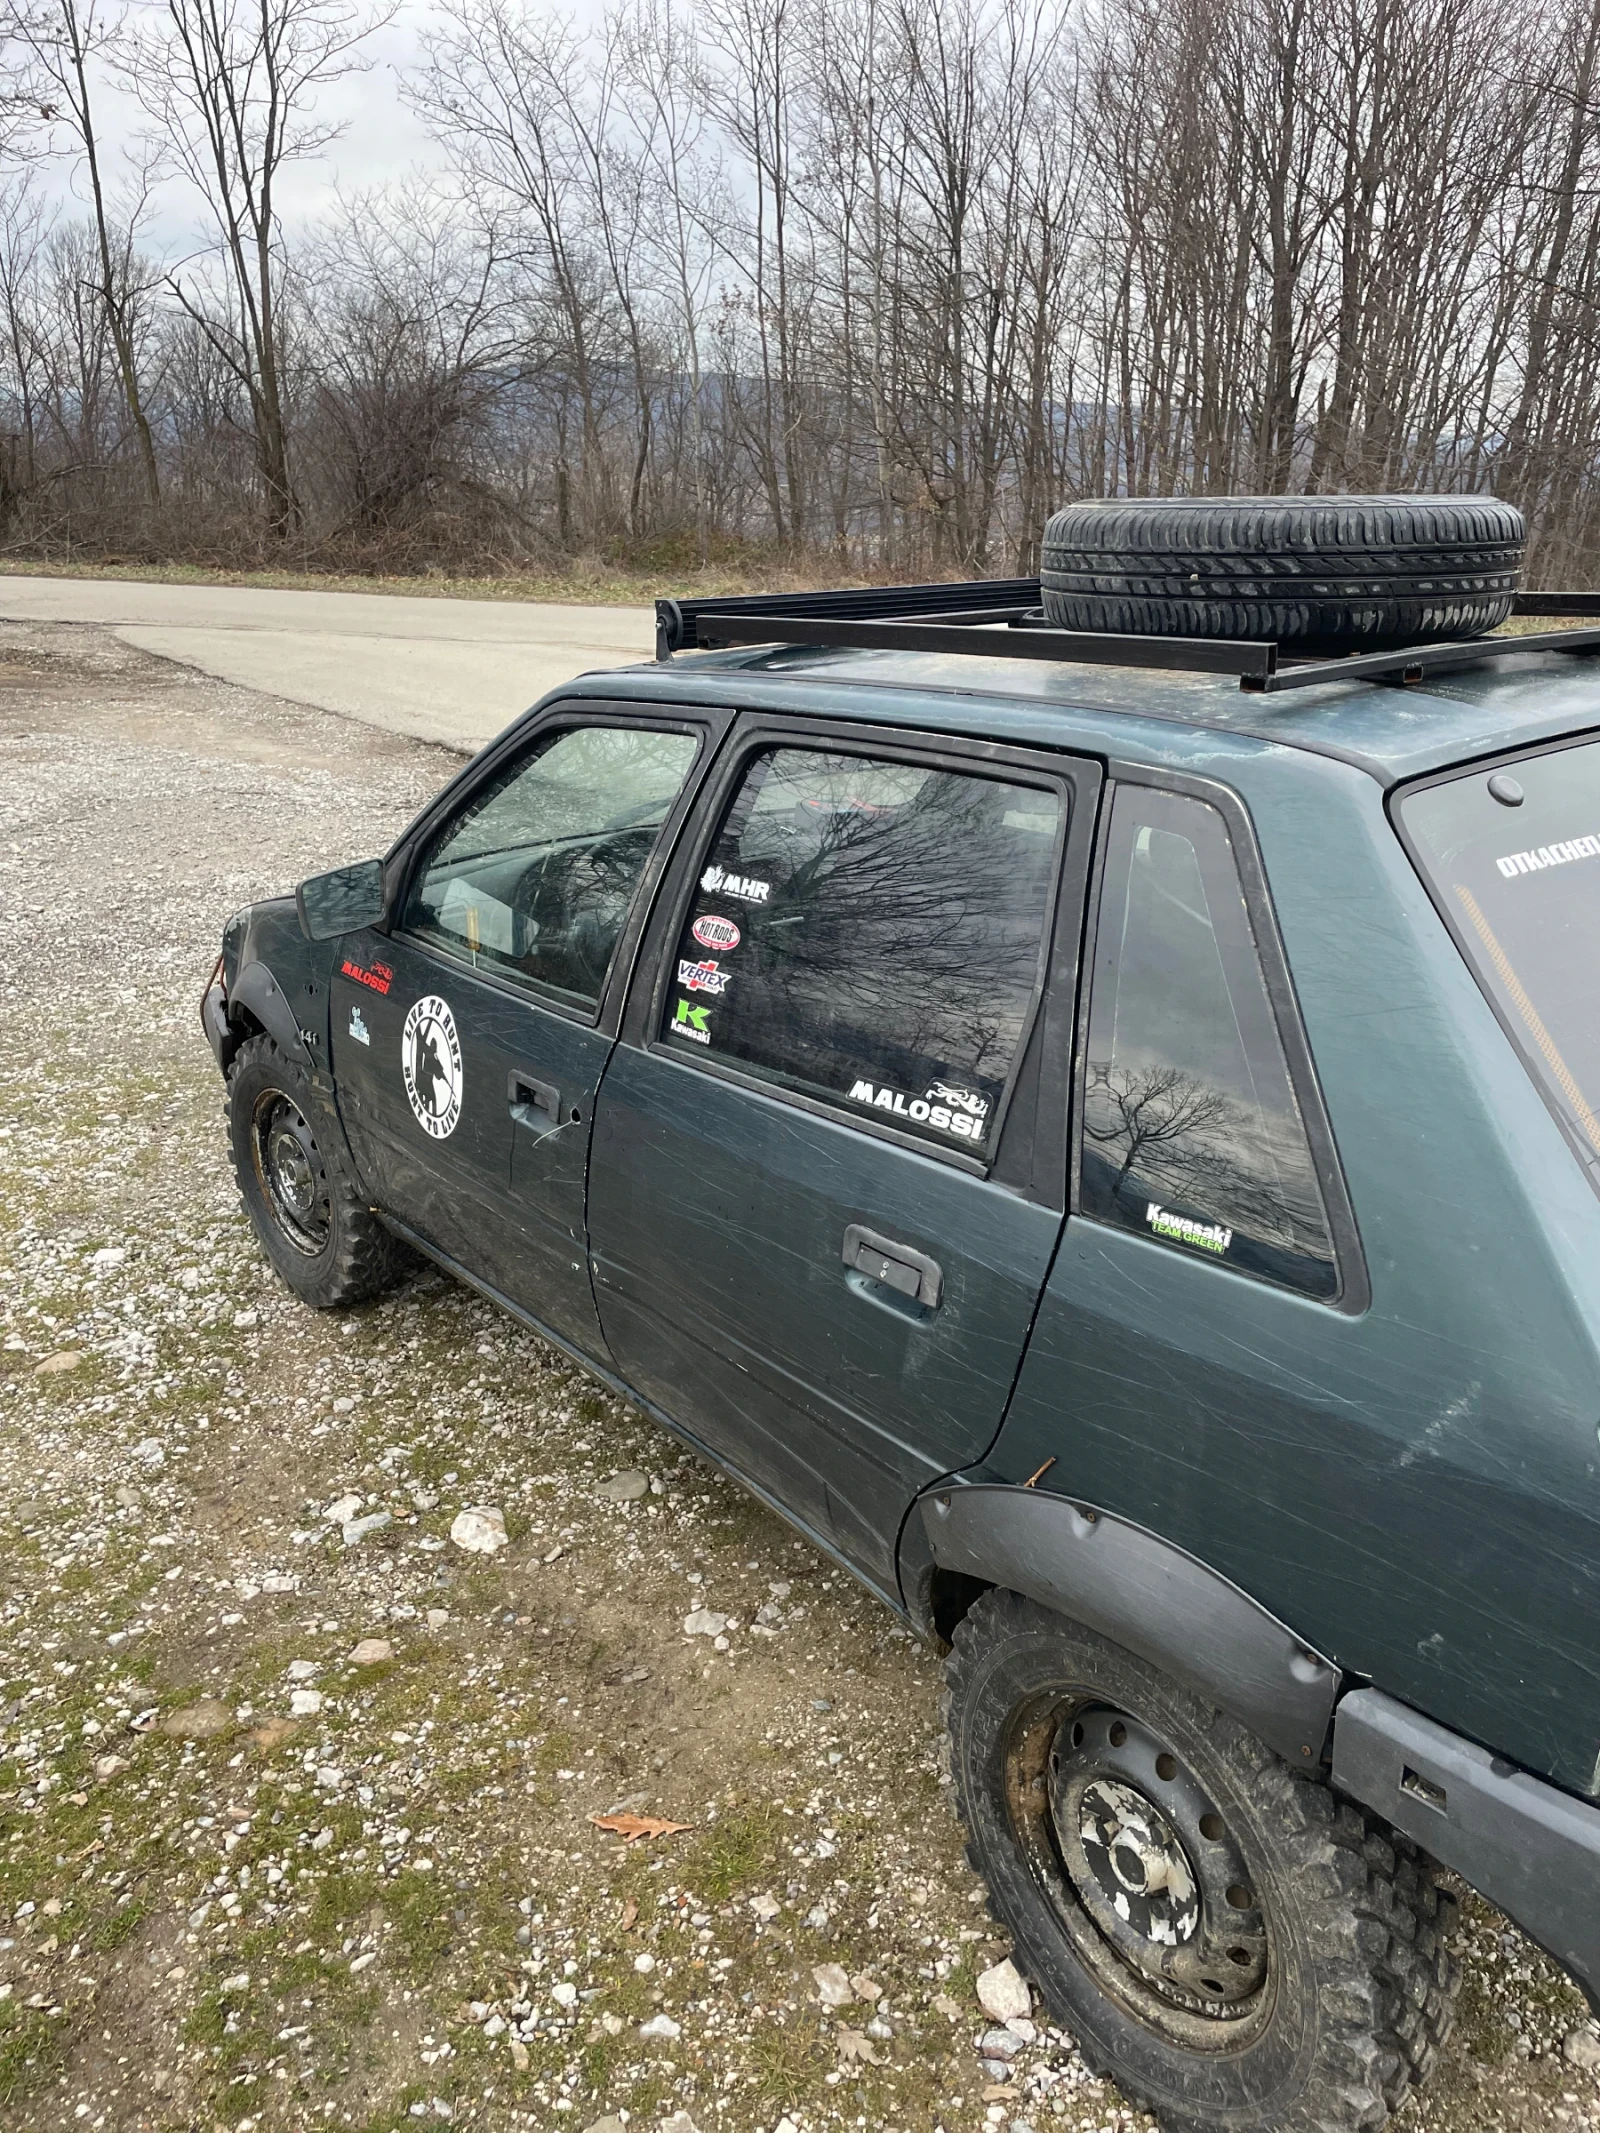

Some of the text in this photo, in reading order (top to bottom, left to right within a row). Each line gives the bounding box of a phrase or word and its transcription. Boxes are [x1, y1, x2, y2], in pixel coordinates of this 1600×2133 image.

[721, 873, 770, 901] MHR
[698, 920, 715, 937] HOT
[712, 923, 735, 943] RODS
[340, 959, 391, 995] MALOSSI
[680, 962, 727, 988] VERTEX
[405, 1002, 424, 1042] LIVE
[429, 999, 442, 1017] TO
[443, 1013, 461, 1072] HUNT
[670, 1017, 711, 1045] Kawasaki
[404, 1066, 459, 1136] HUNT TO LIVE
[849, 1080, 984, 1140] MALOSSI
[1146, 1202, 1233, 1248] Kawasaki
[1152, 1221, 1225, 1254] TEAM GREEN
